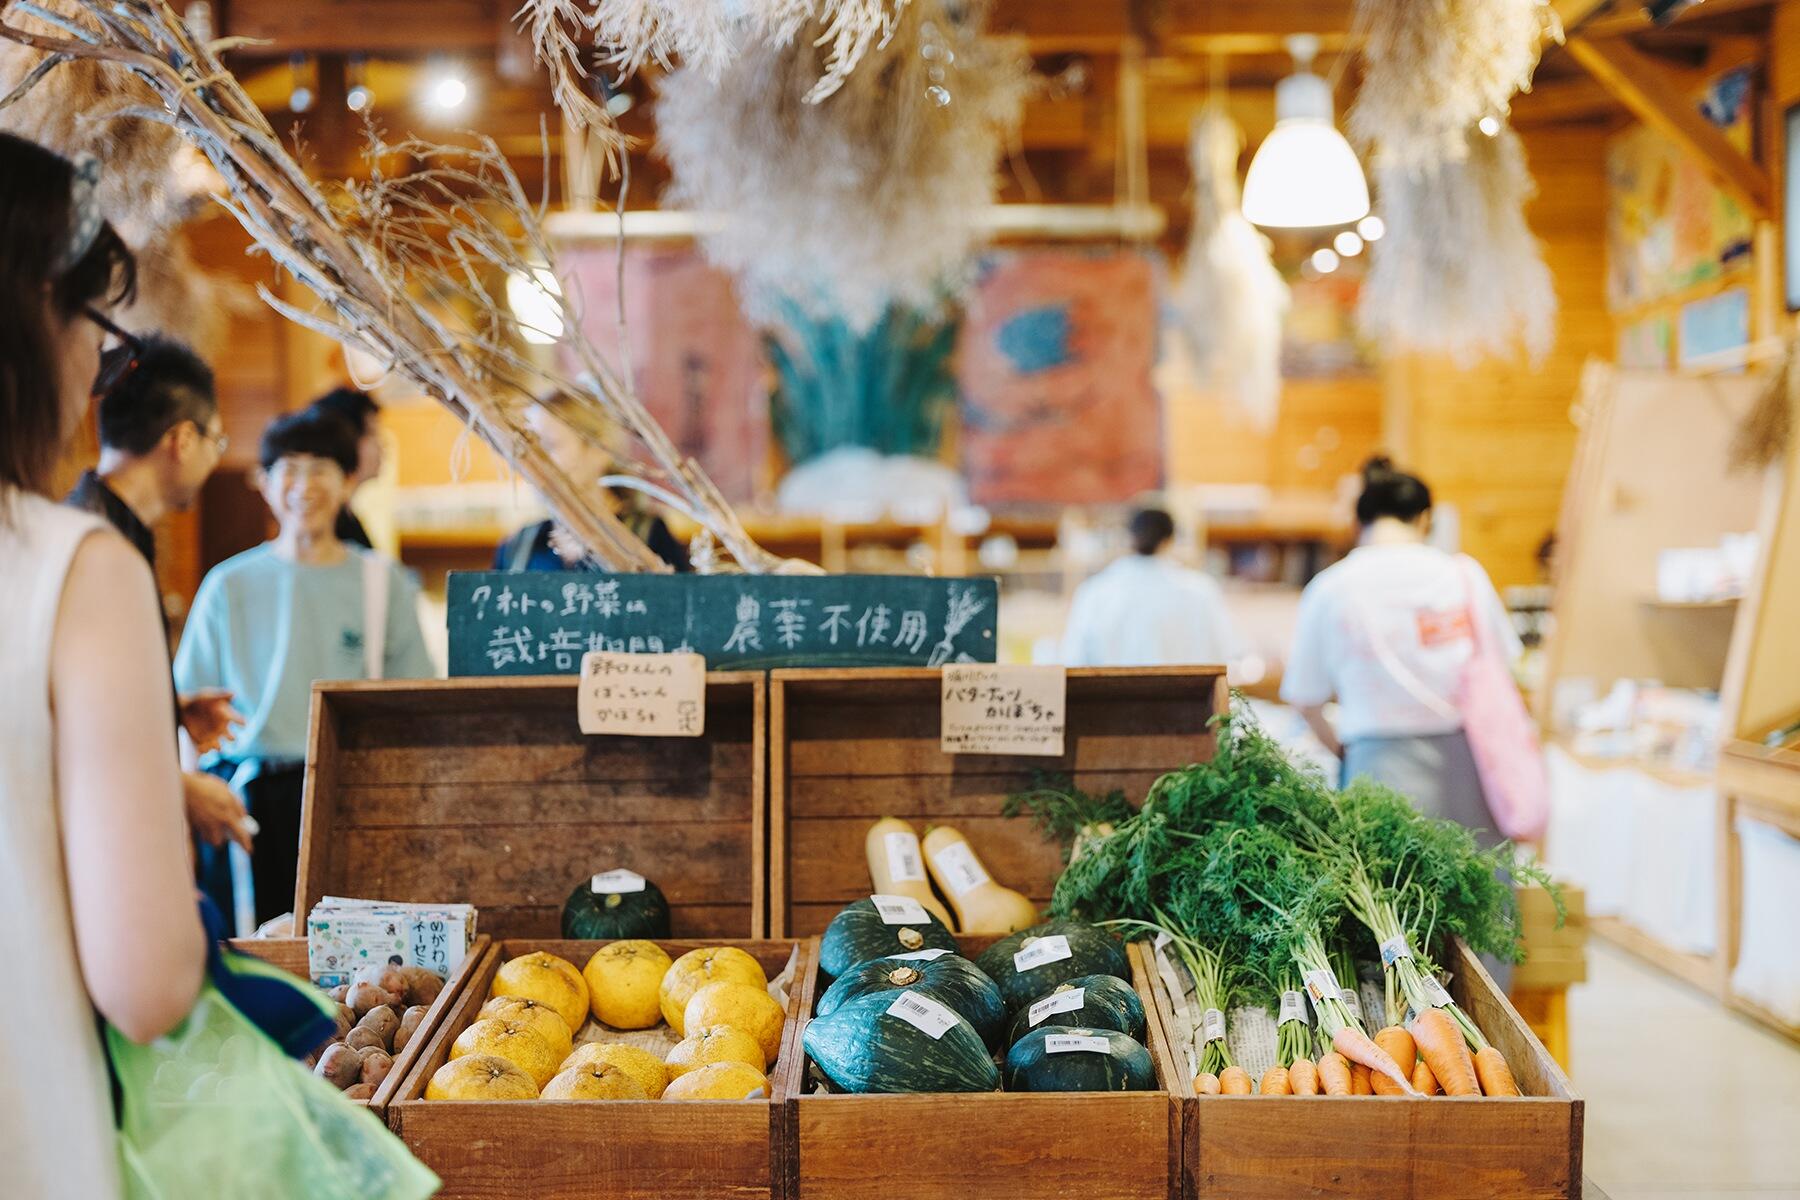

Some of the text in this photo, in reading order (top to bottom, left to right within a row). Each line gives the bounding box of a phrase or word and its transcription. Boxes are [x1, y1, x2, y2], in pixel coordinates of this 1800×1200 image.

[722, 592, 928, 654] 農薬不使用
[945, 686, 1021, 702] バターナッツ
[986, 699, 1055, 720] かぼちゃ
